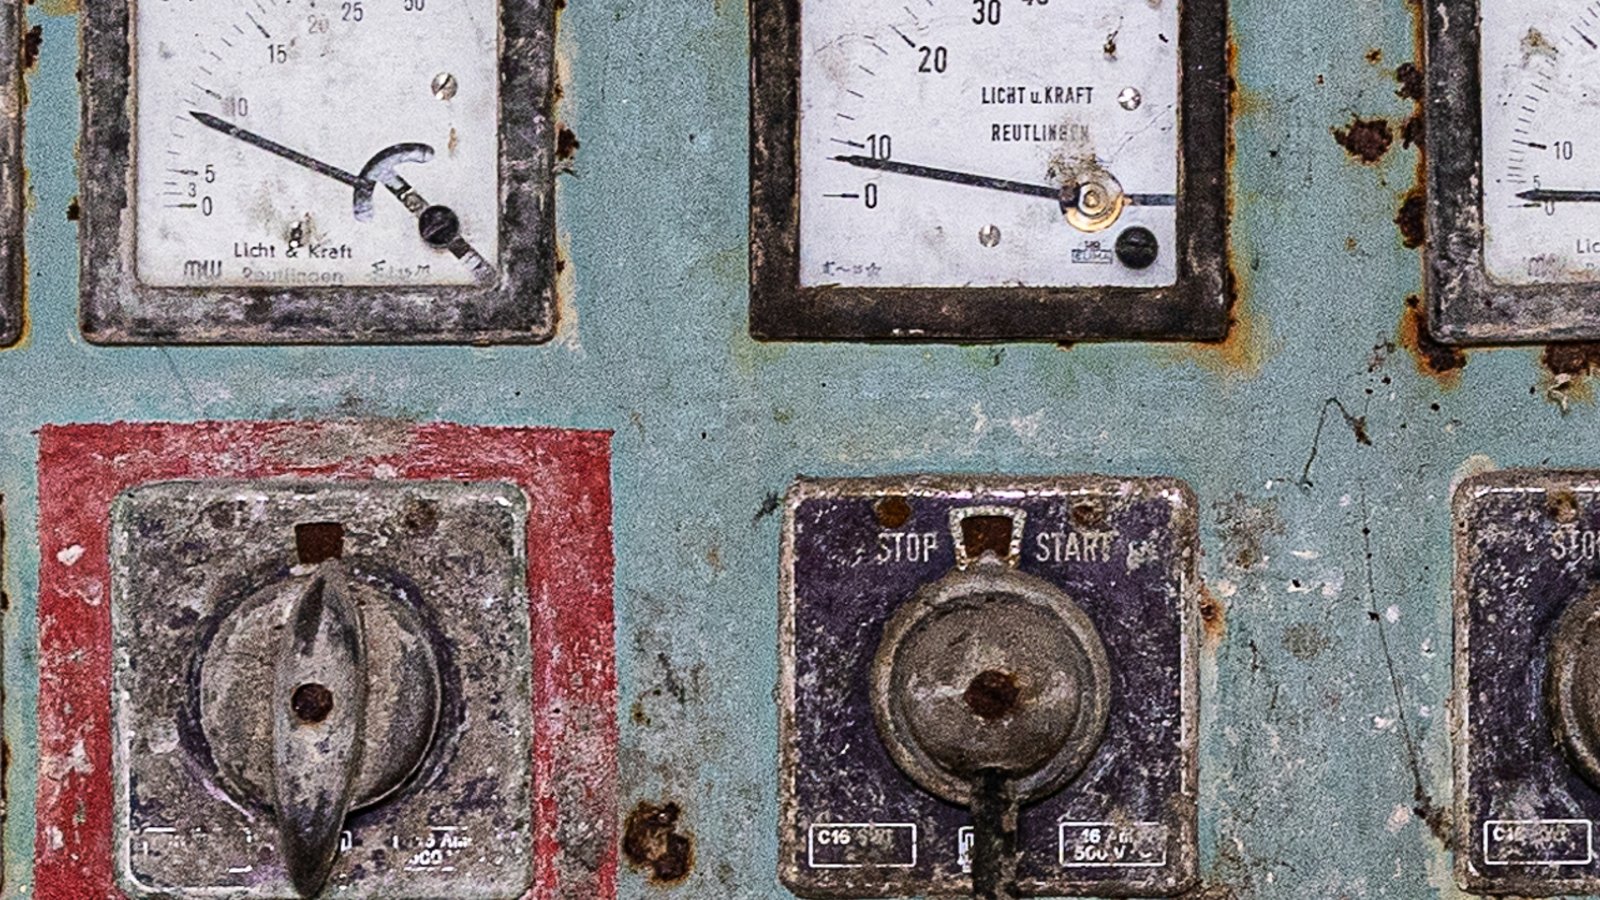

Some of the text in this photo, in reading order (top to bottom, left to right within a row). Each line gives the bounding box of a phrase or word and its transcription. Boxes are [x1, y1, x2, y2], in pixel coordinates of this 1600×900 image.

[341, 1, 364, 22] 25
[972, 0, 1001, 25] 30
[307, 14, 330, 34] 20
[267, 44, 287, 64] 15
[918, 46, 948, 73] 20
[981, 86, 1026, 104] LICHT
[866, 134, 892, 161] 10
[1553, 140, 1573, 160] 10
[204, 165, 216, 184] 5
[188, 183, 197, 198] 3
[864, 183, 878, 209] 0
[201, 197, 213, 216] 0
[234, 242, 276, 258] Licht
[307, 244, 354, 259] Kraft
[878, 532, 1114, 563] STOP START
[1550, 529, 1600, 560] STO
[817, 829, 851, 845] C16
[1080, 828, 1101, 844] 16
